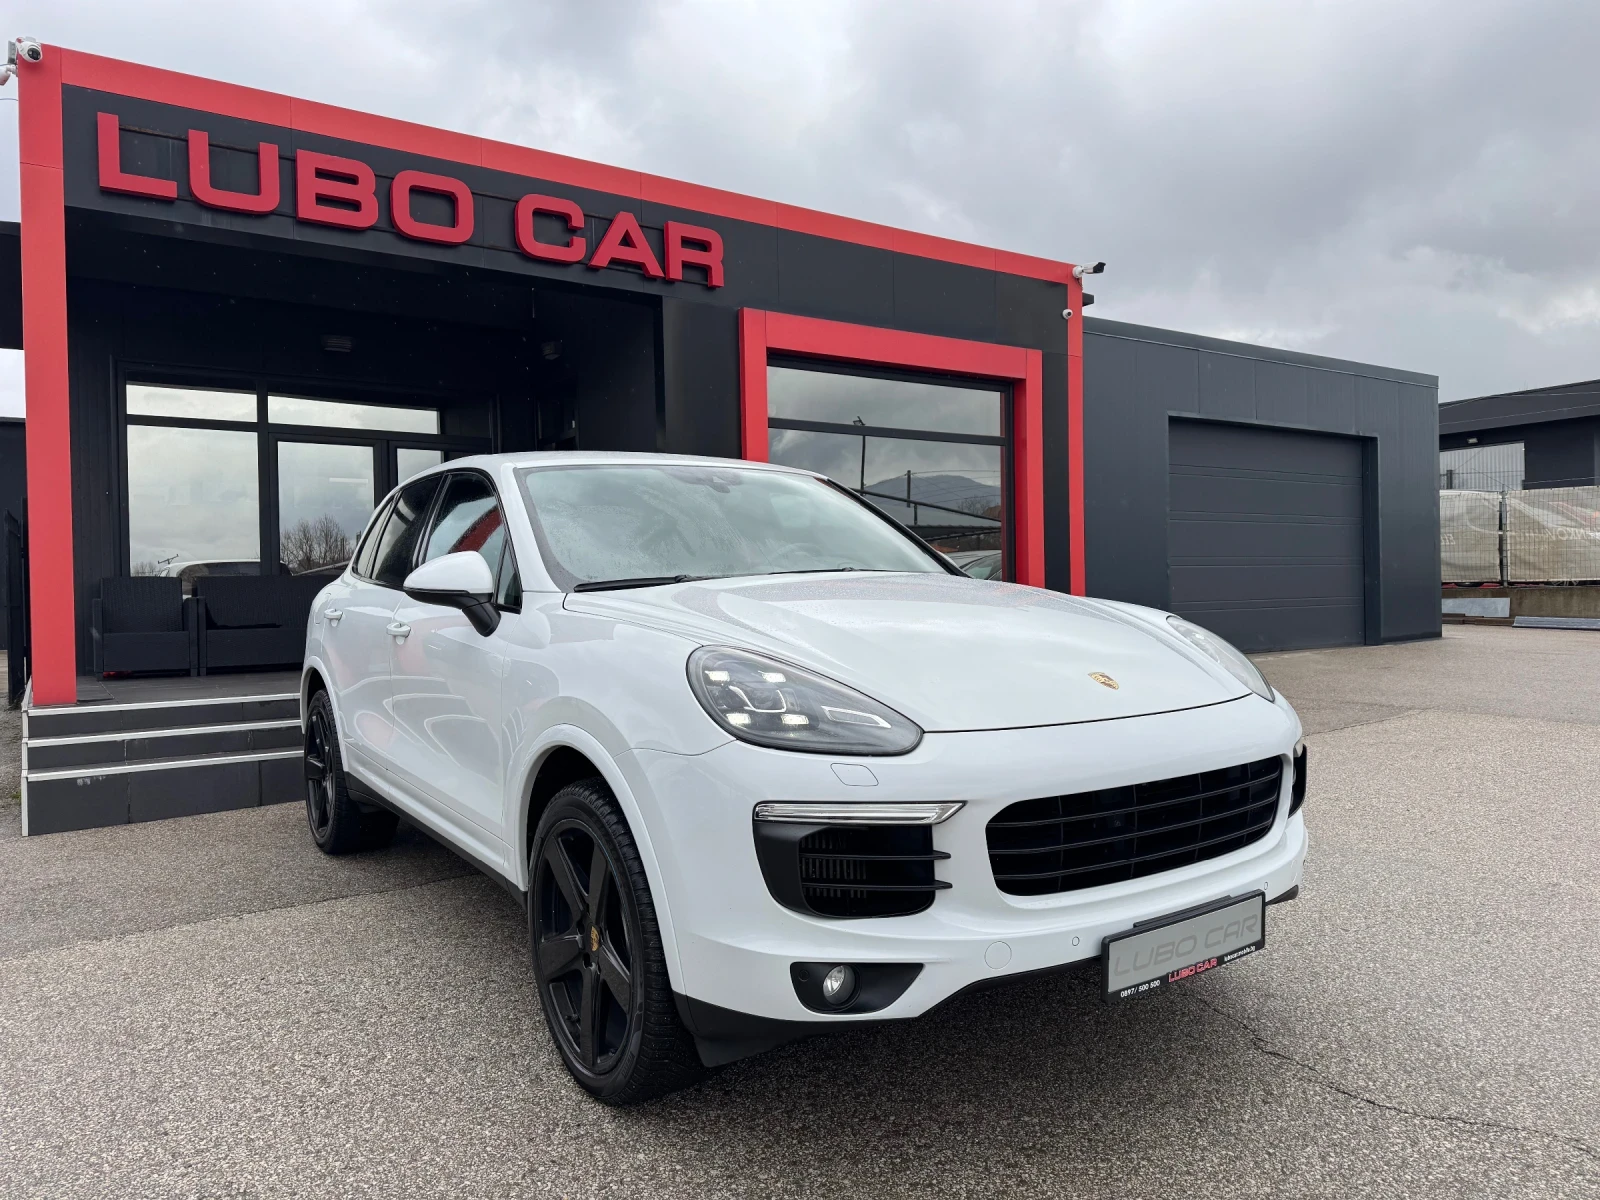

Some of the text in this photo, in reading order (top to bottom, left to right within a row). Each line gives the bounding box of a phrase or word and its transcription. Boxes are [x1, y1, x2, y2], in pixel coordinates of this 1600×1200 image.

[97, 112, 724, 288] LUBO CAR
[1113, 914, 1258, 976] LUBO CAR
[1138, 983, 1149, 992] 500
[1150, 979, 1160, 988] 500
[1168, 957, 1218, 983] LUBO CAR
